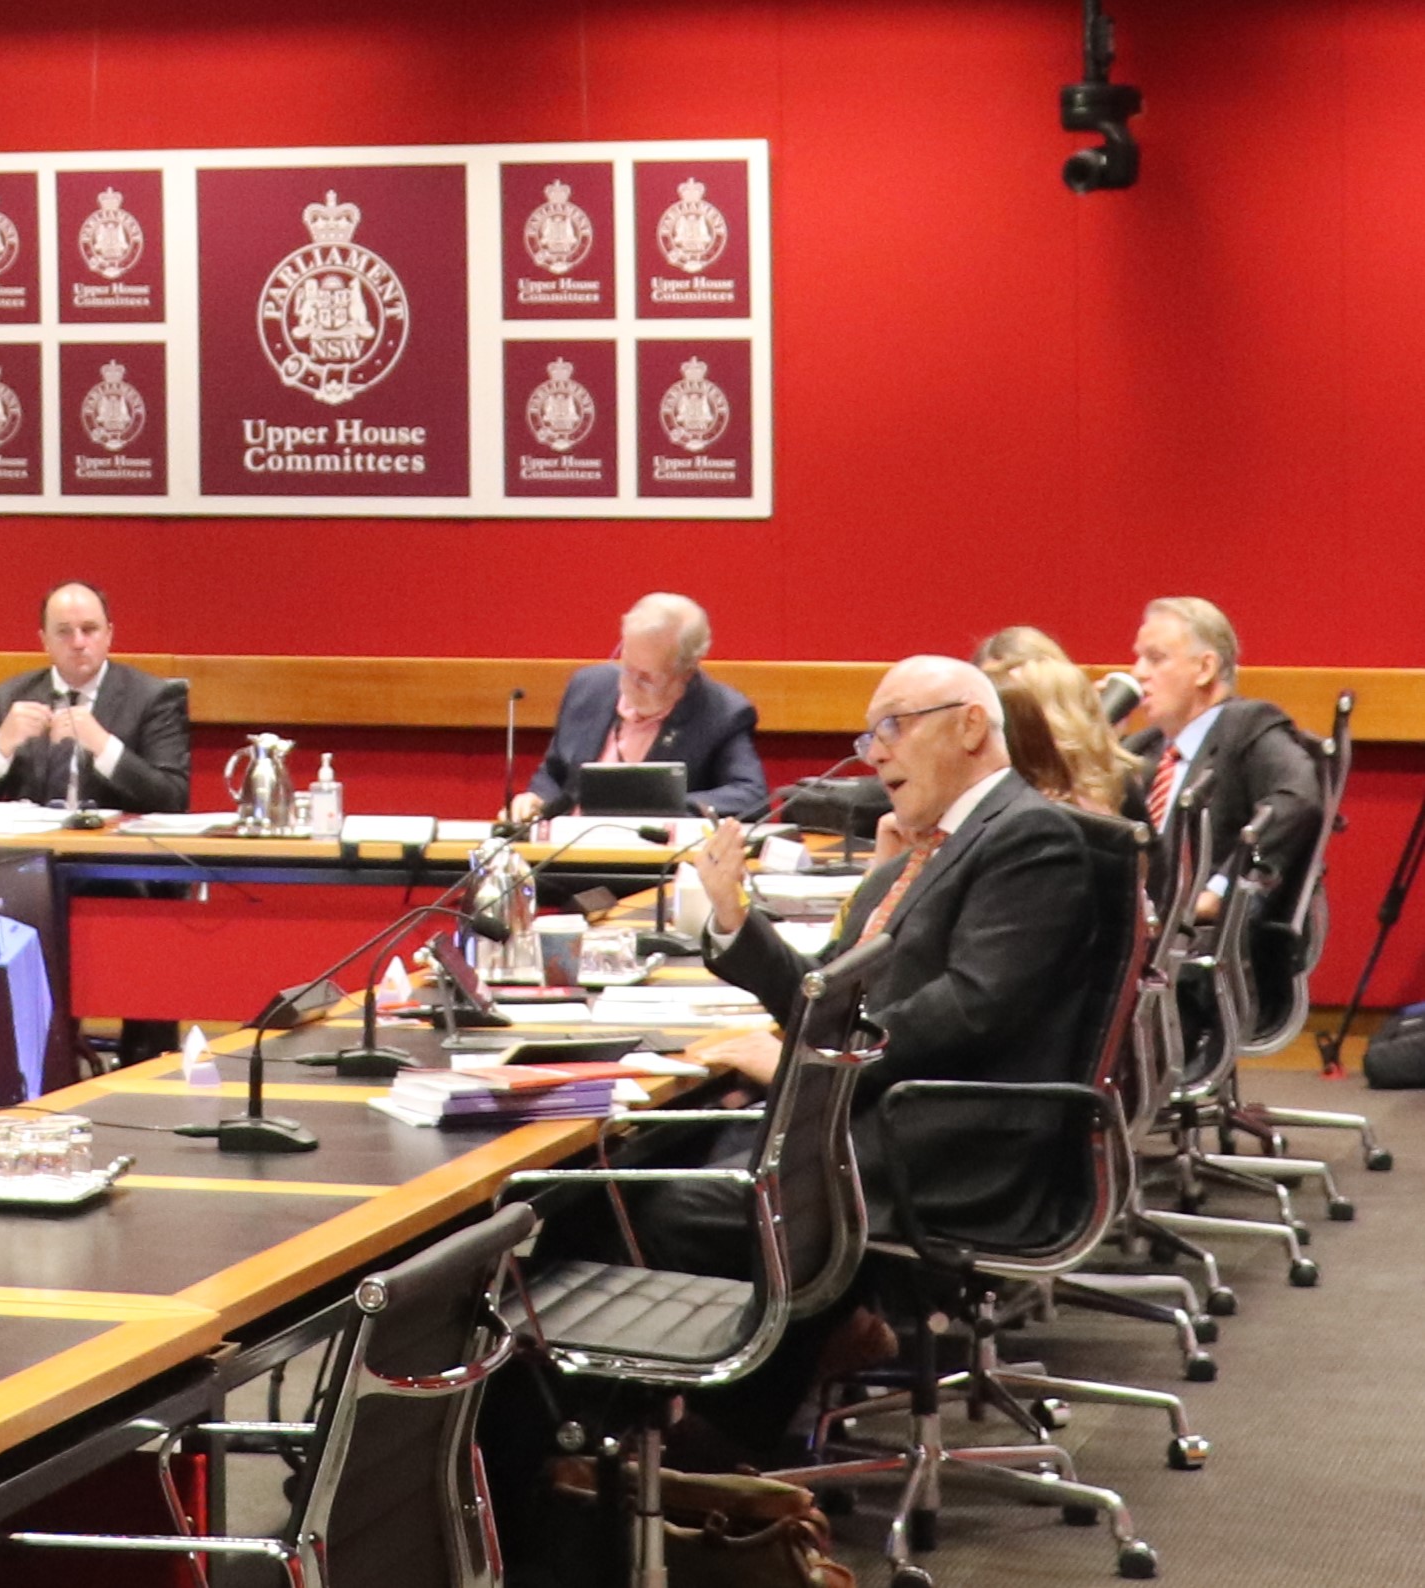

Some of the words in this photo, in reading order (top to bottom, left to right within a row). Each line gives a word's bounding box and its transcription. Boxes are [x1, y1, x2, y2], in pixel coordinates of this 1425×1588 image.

[73, 282, 110, 297] Upper
[112, 282, 150, 295] House
[263, 246, 404, 320] PARLIAMENT
[518, 278, 556, 293] Upper
[559, 278, 600, 289] House
[651, 276, 690, 292] Upper
[693, 276, 734, 289] House
[74, 295, 150, 307] Committees
[518, 291, 600, 303] Committees
[651, 290, 734, 302] Committees
[310, 338, 364, 359] NSW
[243, 419, 329, 451] Upper
[335, 419, 426, 444] House
[76, 455, 111, 470] Upper
[114, 455, 152, 466] House
[243, 447, 426, 472] Committees
[520, 455, 558, 469] Upper
[561, 455, 601, 467] House
[653, 455, 692, 469] Upper
[695, 455, 736, 467] House
[76, 467, 152, 479] Committees
[520, 468, 602, 480] Committees
[653, 468, 736, 480] Committees
